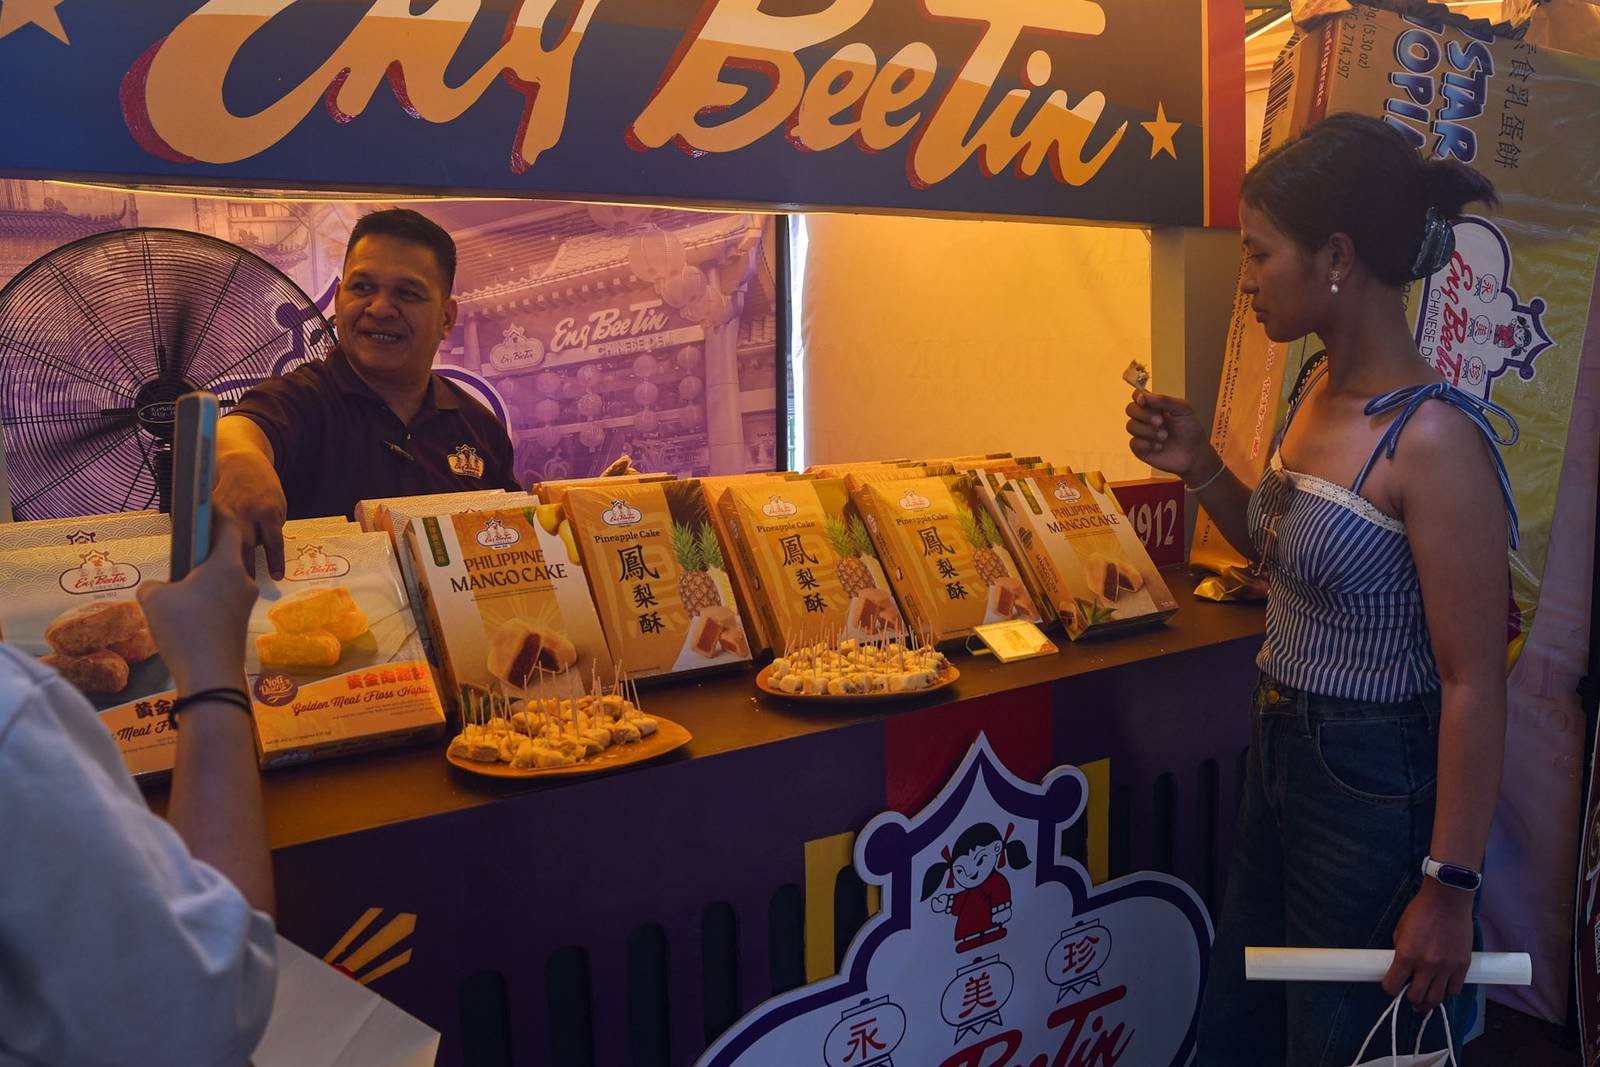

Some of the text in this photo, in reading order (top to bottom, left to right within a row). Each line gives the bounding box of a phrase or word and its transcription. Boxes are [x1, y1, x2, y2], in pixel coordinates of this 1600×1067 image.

[1423, 288, 1441, 343] CHINESE
[551, 317, 590, 352] Eng
[896, 517, 931, 526] Pineapple
[1051, 503, 1103, 518] PHILIPPINE
[756, 521, 816, 533] Pineapple Cake
[1046, 513, 1120, 534] MANGO CAKE
[594, 529, 661, 544] Pineapple Cake
[464, 550, 545, 572] PHILIPPINE
[779, 534, 829, 613] 鳳梨酥
[917, 526, 968, 600] 鳳梨酥
[450, 563, 568, 592] MANGO CAKE
[617, 544, 665, 634] 鳳梨酥
[291, 703, 329, 716] Golden
[330, 695, 361, 708] Meat
[363, 691, 394, 703] Floss
[117, 723, 152, 741] Meat
[843, 935, 1099, 1062] 永 美 珍
